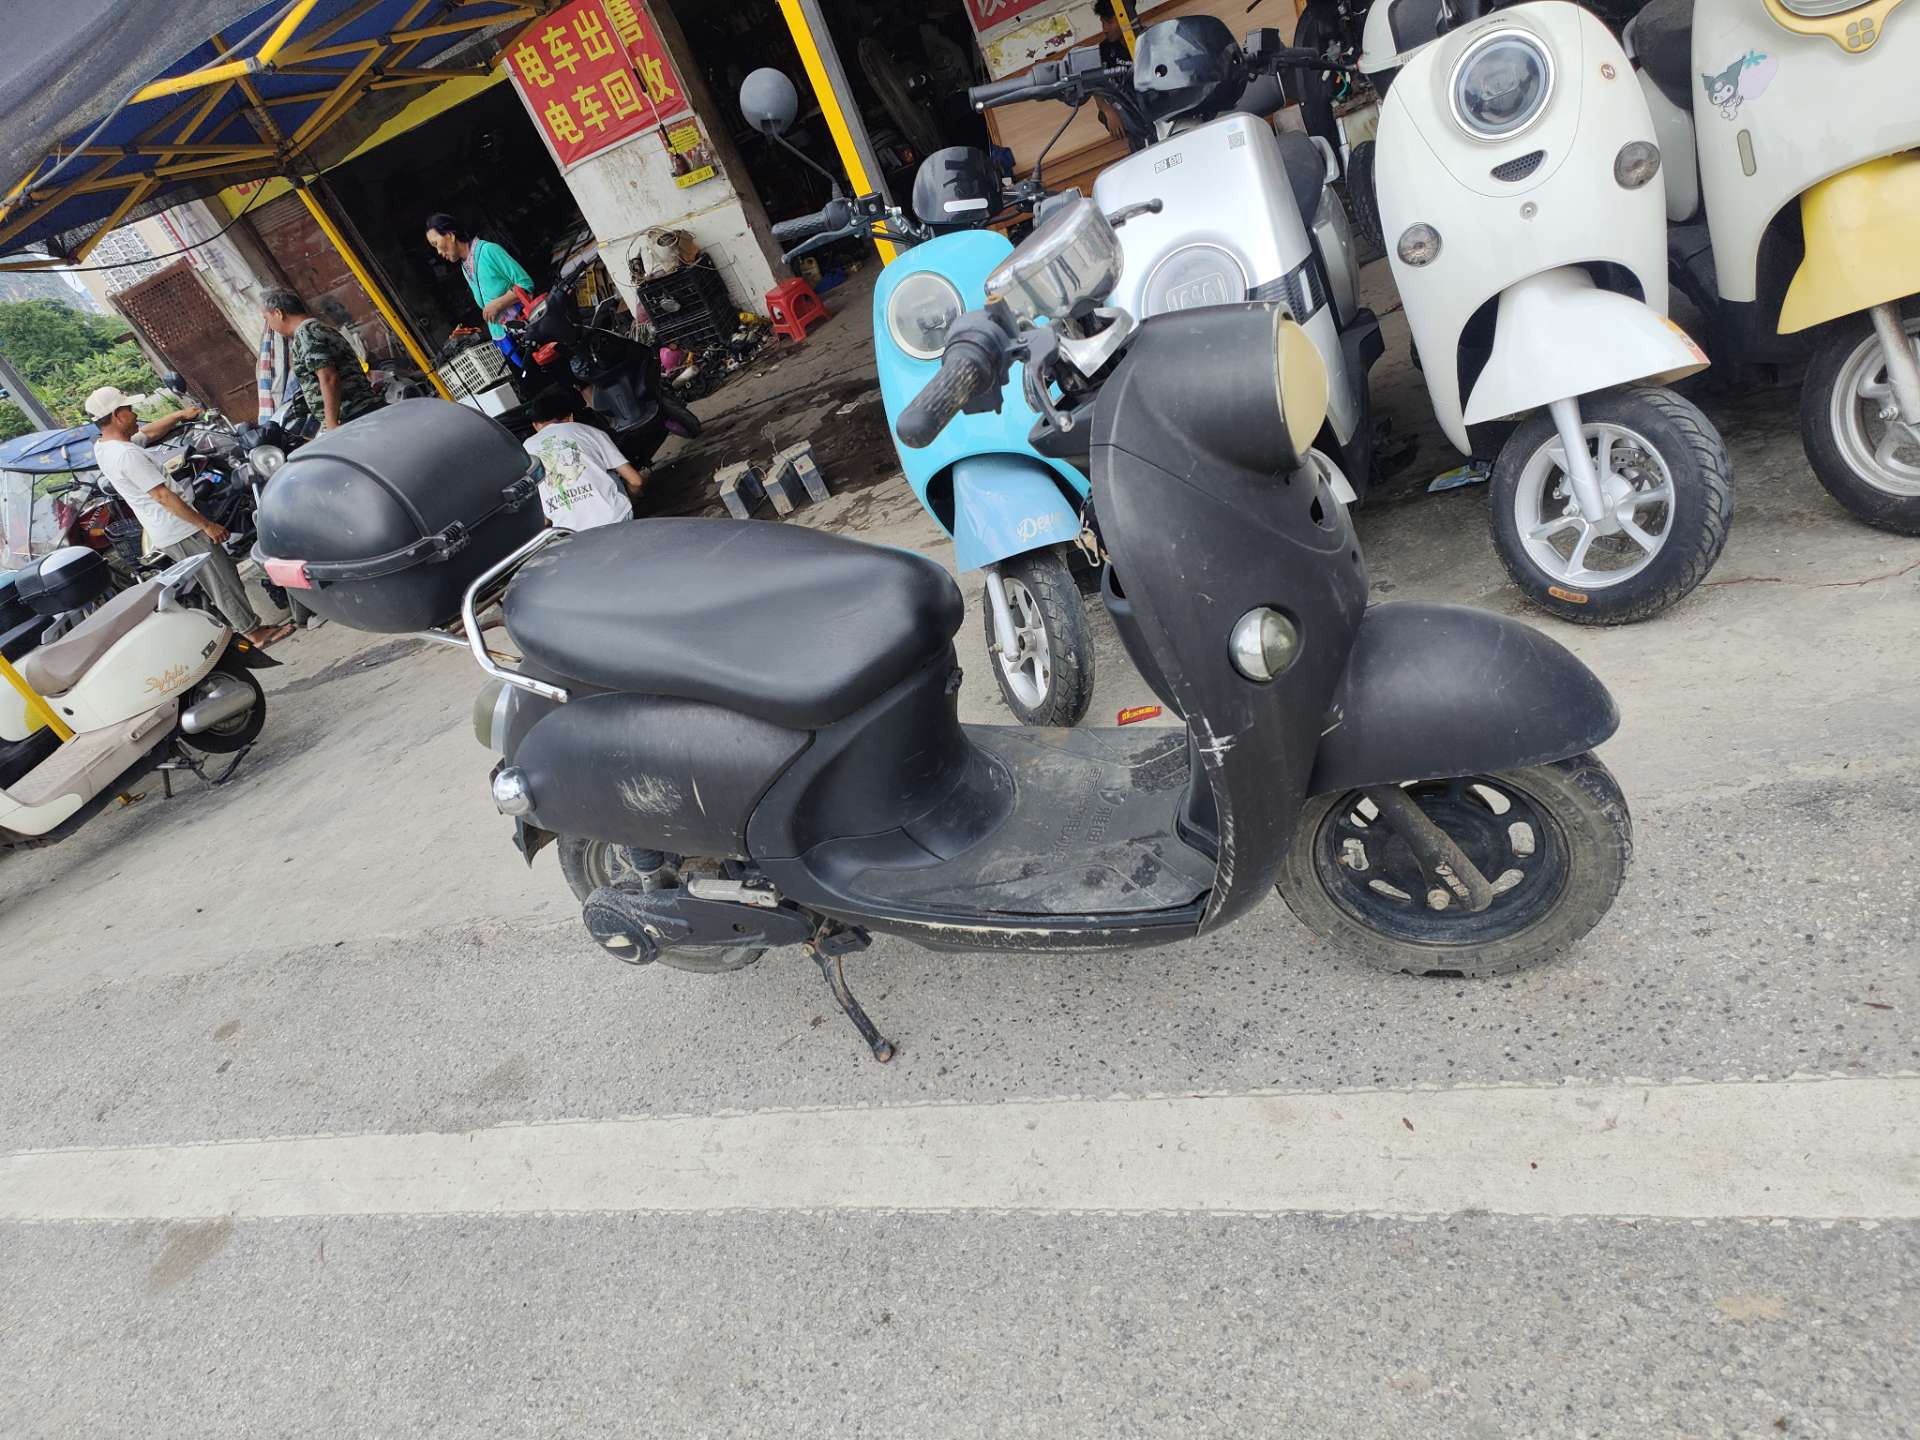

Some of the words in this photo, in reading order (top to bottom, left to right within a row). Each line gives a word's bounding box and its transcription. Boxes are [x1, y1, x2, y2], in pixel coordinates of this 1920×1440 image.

[514, 0, 644, 88] 电车出售
[544, 53, 675, 144] 电车回收
